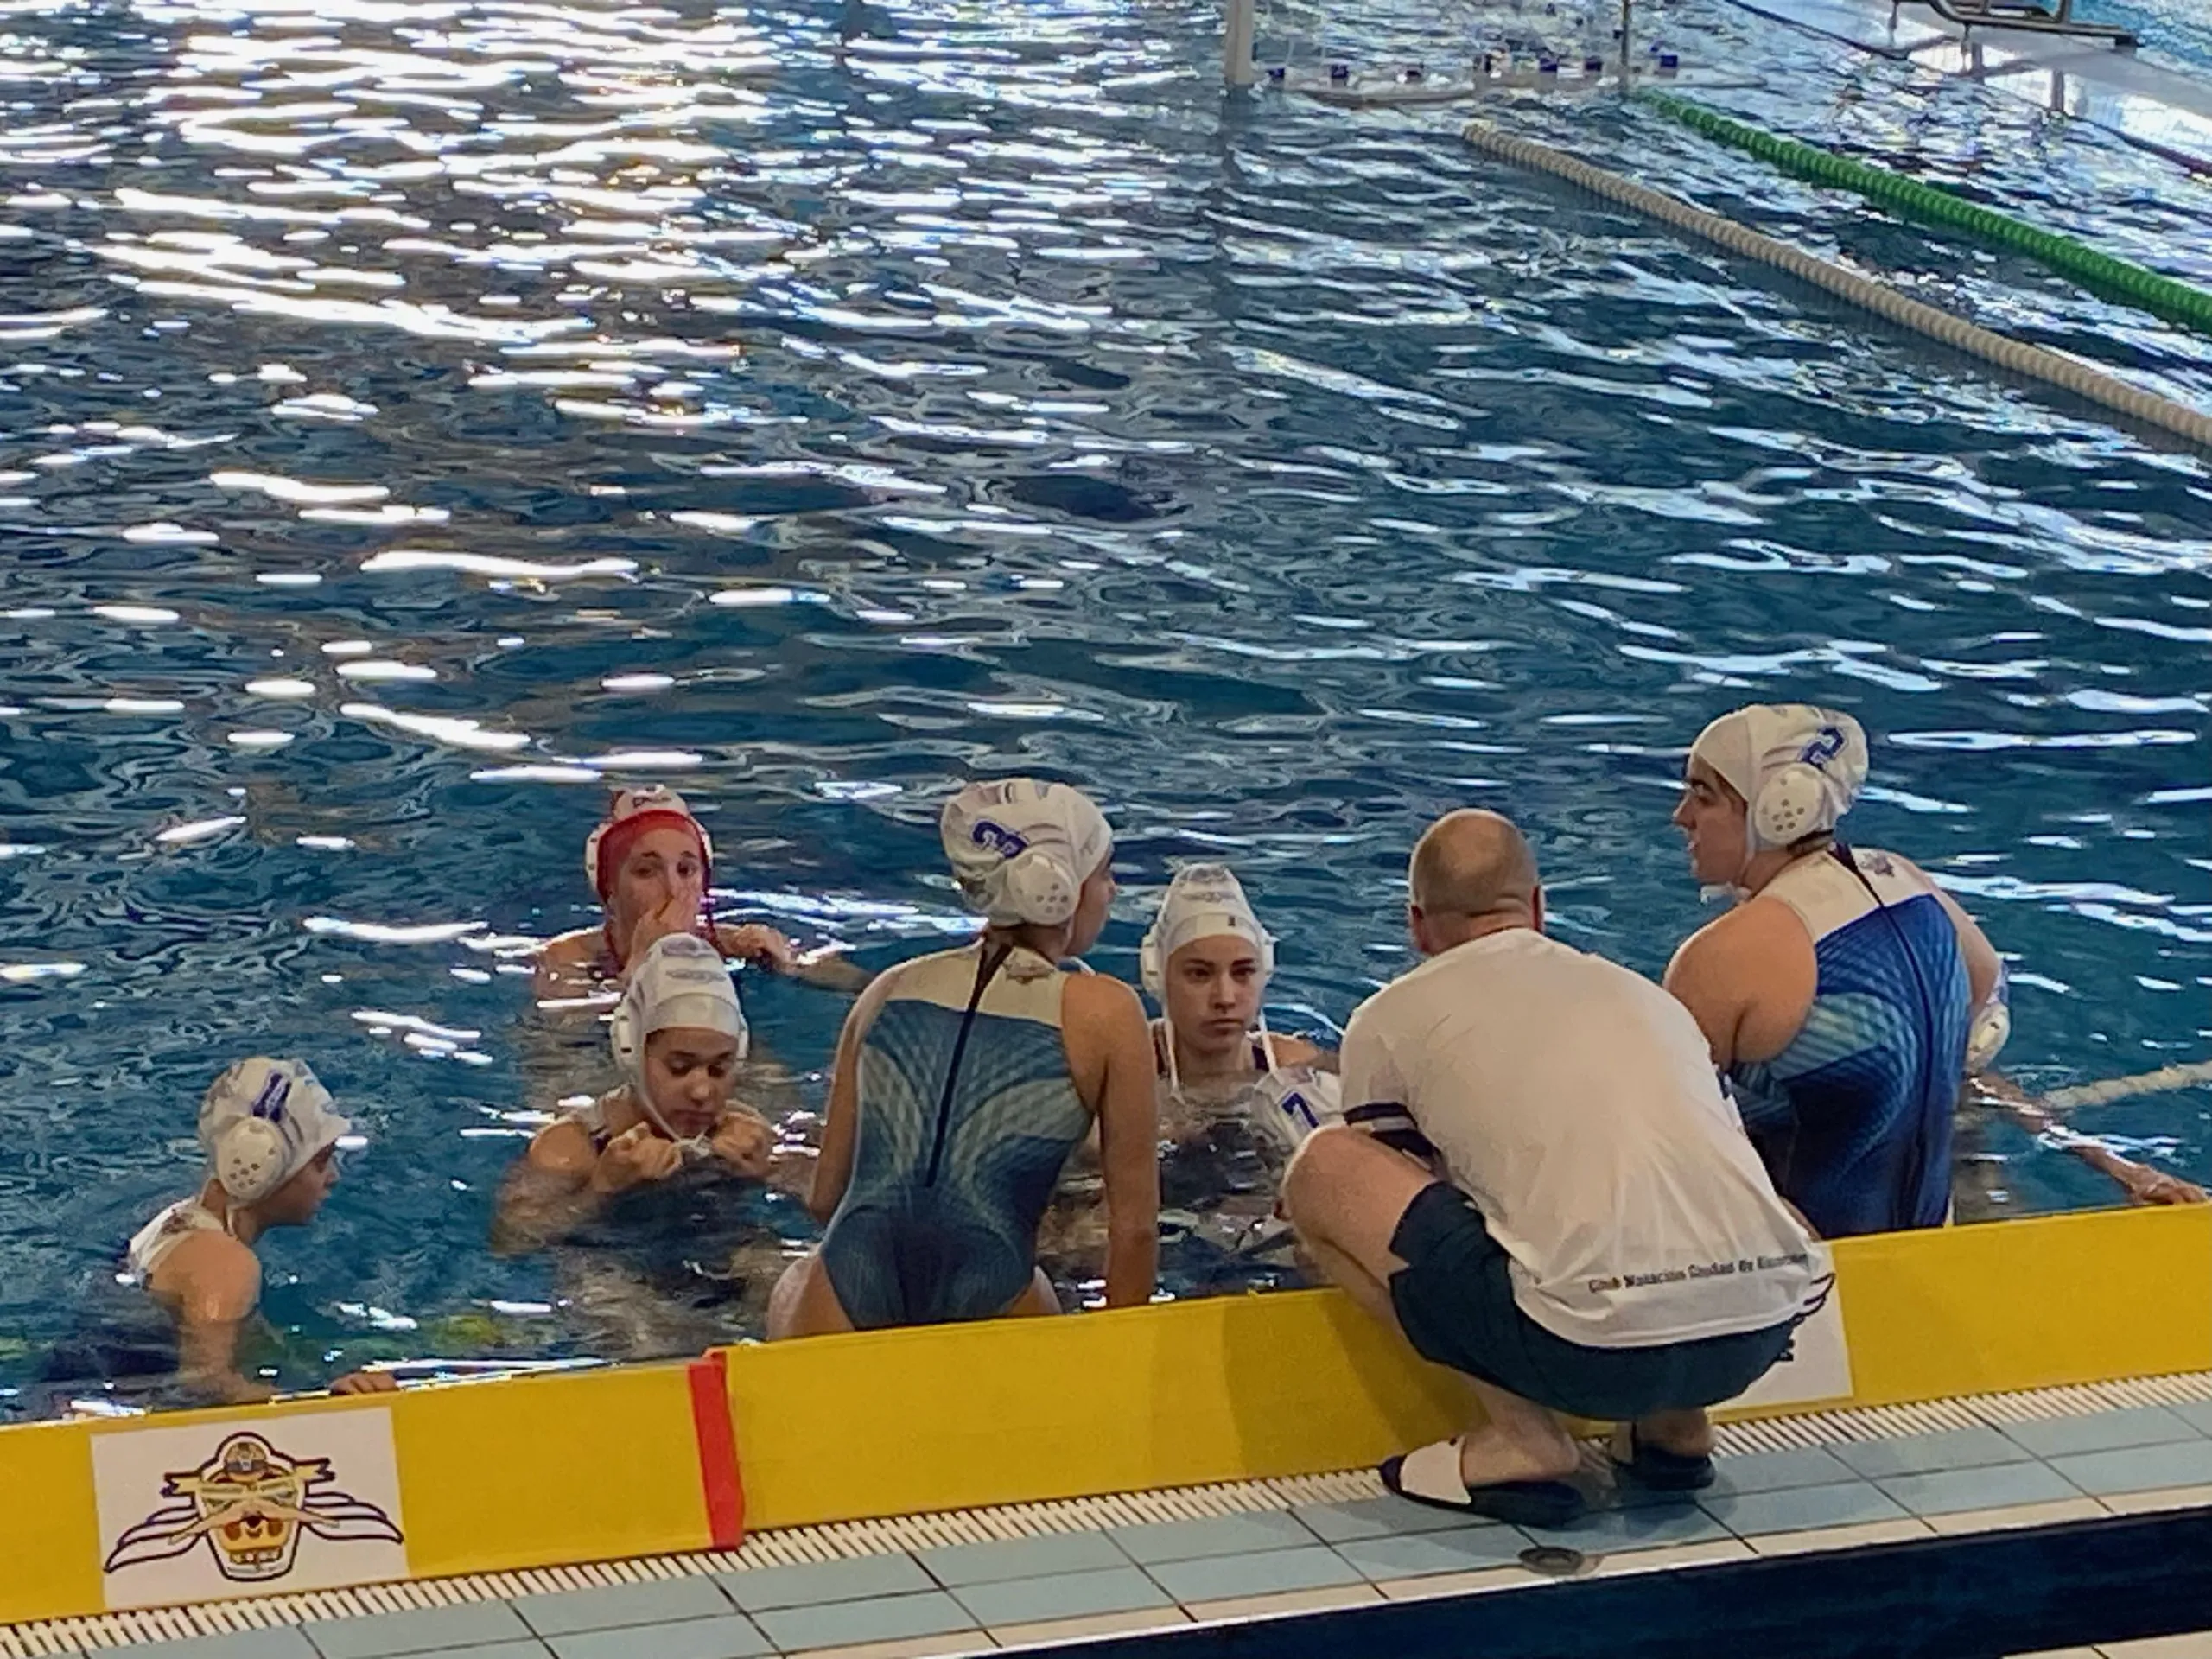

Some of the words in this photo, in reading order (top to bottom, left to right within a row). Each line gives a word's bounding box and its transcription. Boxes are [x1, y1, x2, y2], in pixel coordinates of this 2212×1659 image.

[1797, 725, 1846, 772] 2
[969, 818, 1030, 860] 3
[1281, 1091, 1319, 1129] 7
